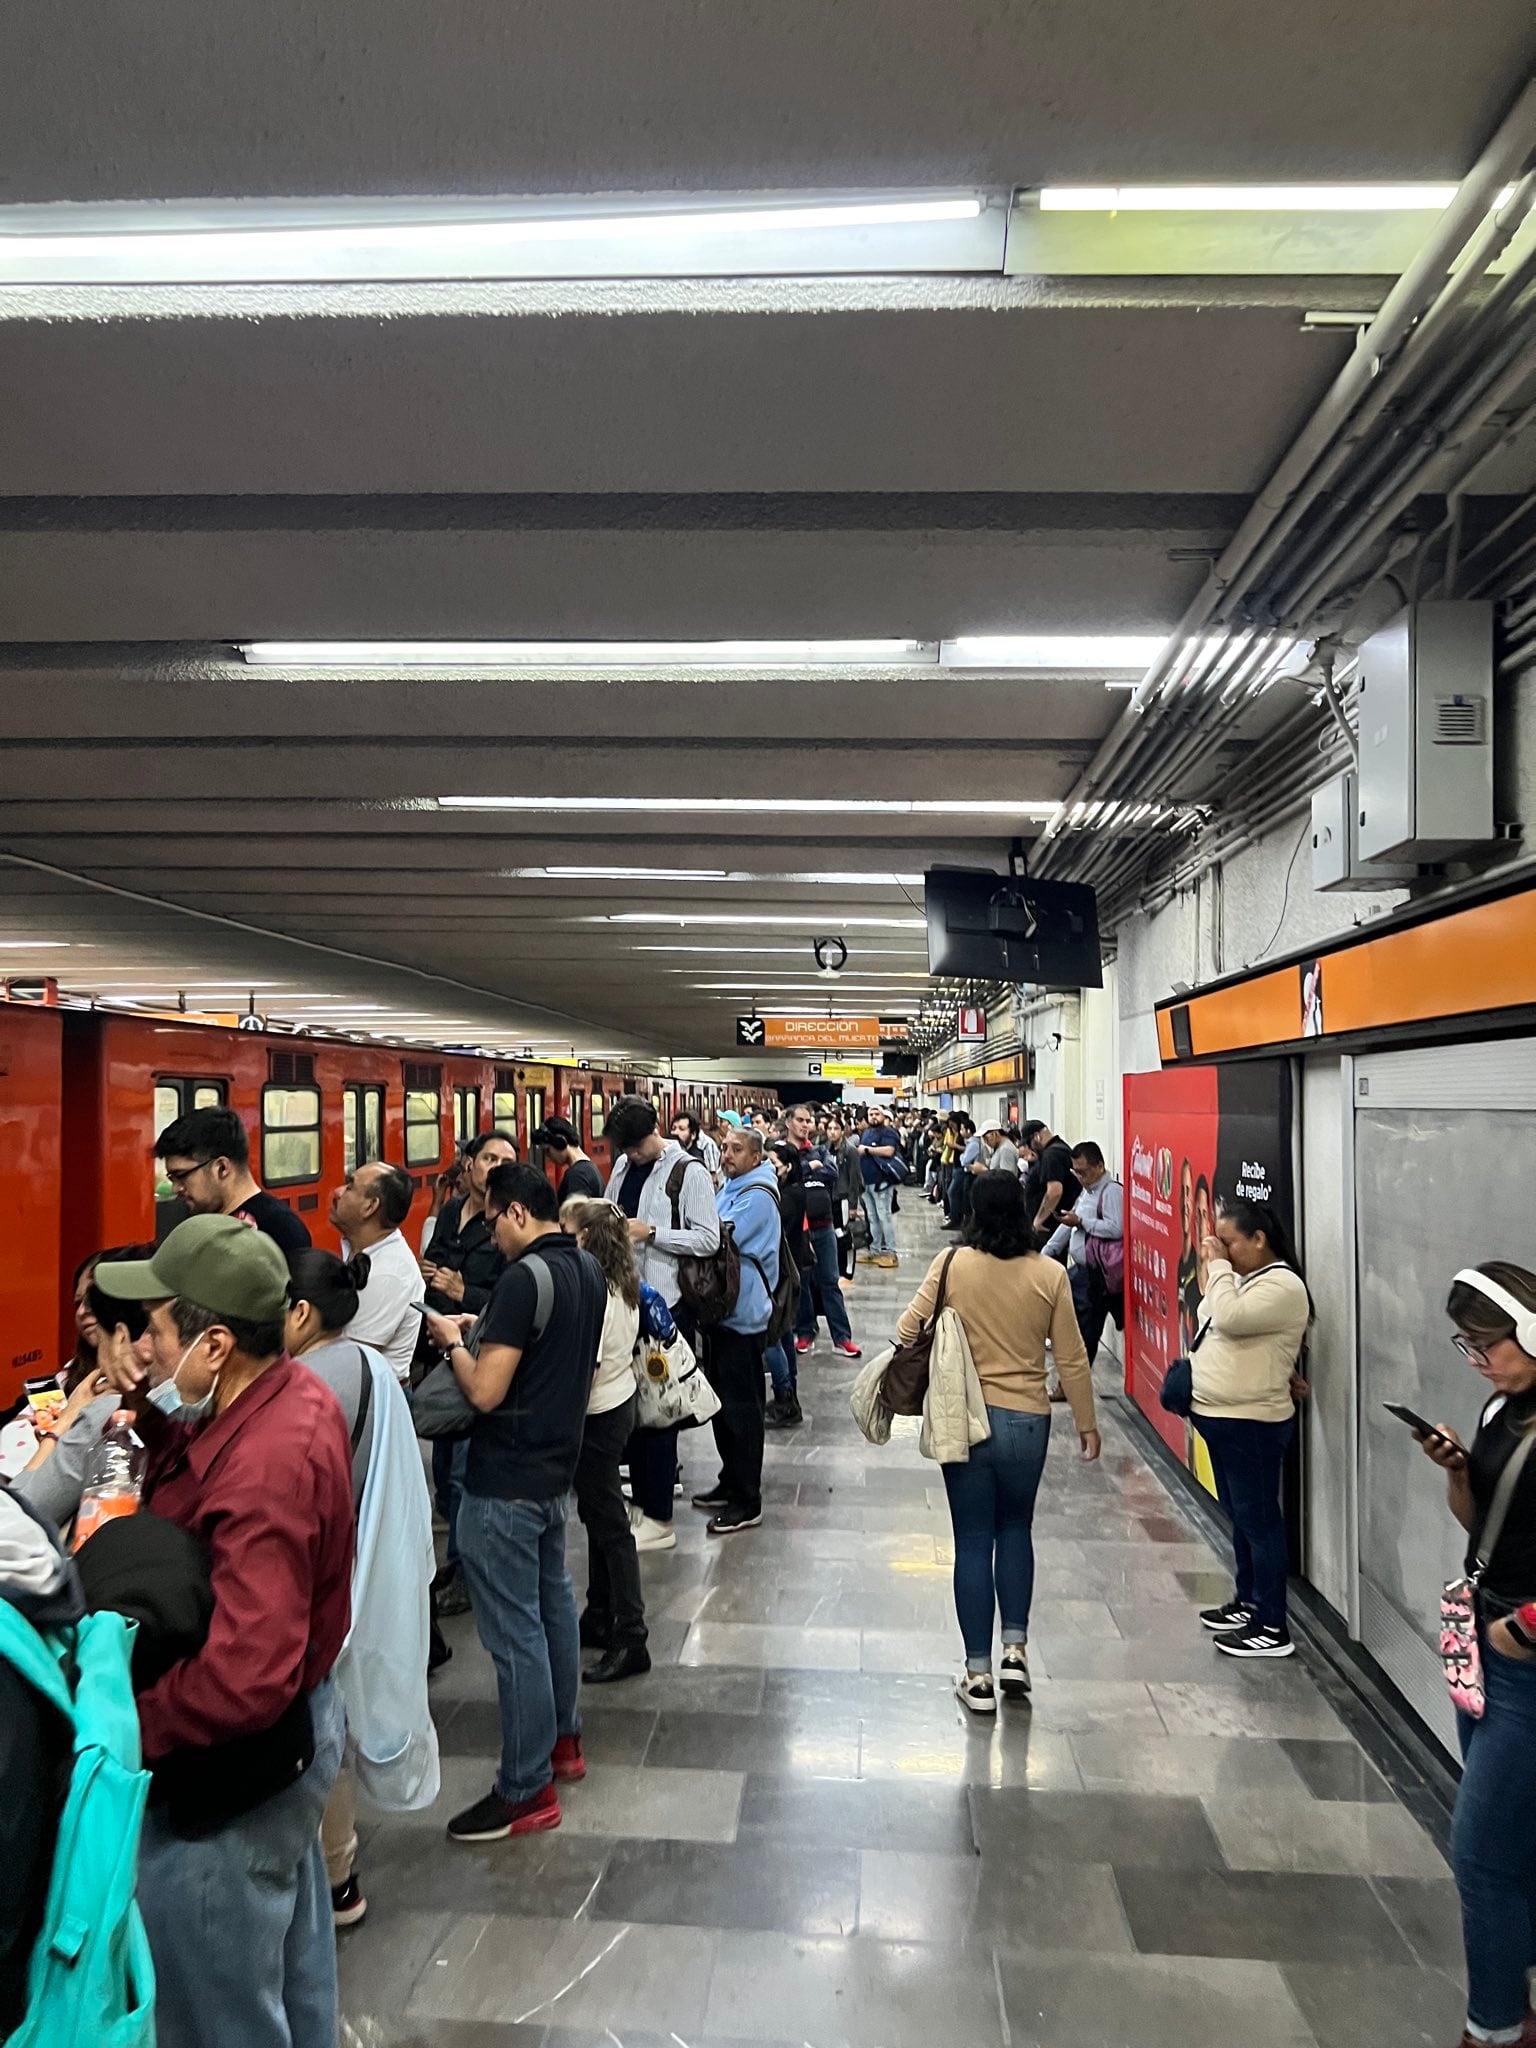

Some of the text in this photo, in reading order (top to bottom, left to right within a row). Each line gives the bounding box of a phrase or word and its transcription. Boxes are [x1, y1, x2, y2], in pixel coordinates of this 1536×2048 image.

[810, 1064, 820, 1074] C
[1241, 1161, 1266, 1180] Recibe
[1236, 1180, 1245, 1197] de
